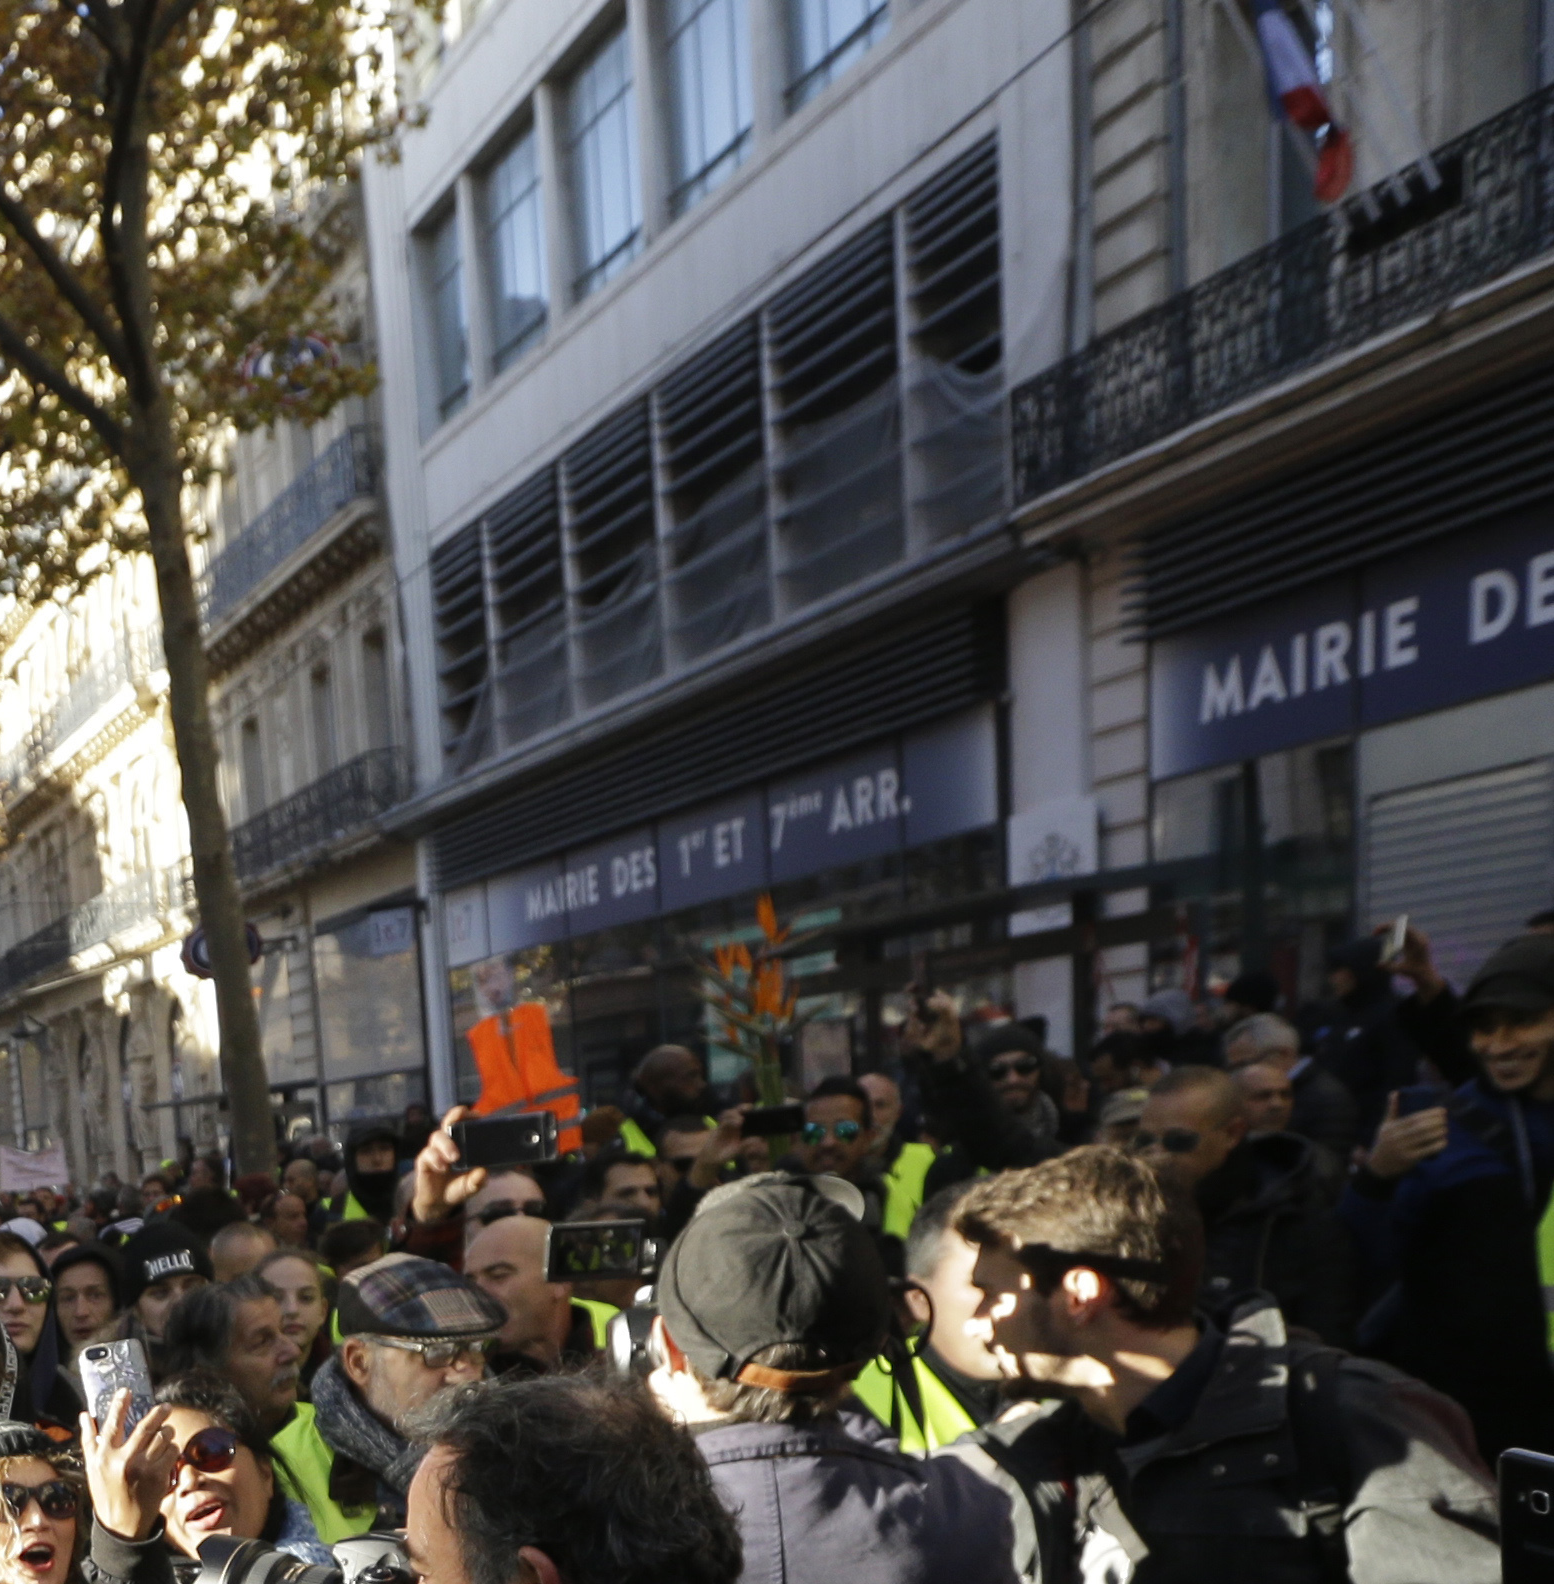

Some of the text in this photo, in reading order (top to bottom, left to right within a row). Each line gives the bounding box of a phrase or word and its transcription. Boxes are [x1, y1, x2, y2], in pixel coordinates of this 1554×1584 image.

[1199, 549, 1554, 726] MAIRIE DE
[525, 863, 601, 924] MAIRIE
[609, 845, 658, 899] DES
[712, 816, 746, 869] ET
[827, 767, 913, 834] ARR.
[148, 1251, 191, 1277] HELLO
